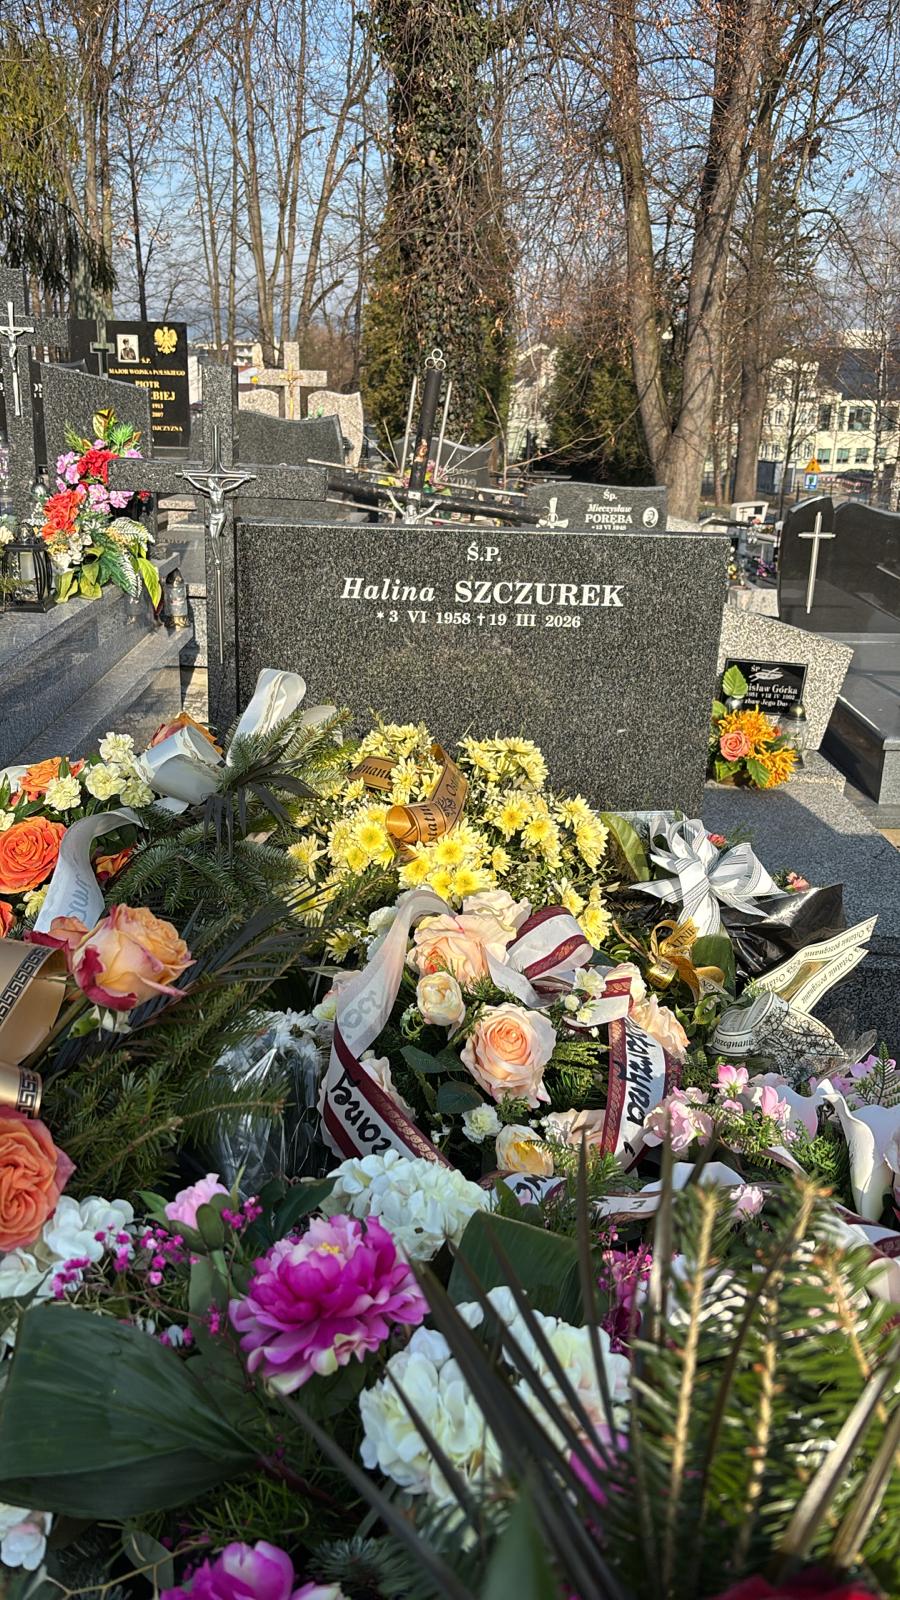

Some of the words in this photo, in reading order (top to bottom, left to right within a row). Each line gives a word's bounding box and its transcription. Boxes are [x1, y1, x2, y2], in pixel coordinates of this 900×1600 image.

[135, 380, 160, 388] PIOTR
[151, 391, 176, 401] BIEJ
[585, 514, 633, 525] PORĘBA
[466, 540, 501, 562] Ś.P.
[340, 577, 435, 601] Halina
[455, 580, 624, 607] SZCZUREK
[407, 610, 427, 623] VI
[436, 612, 470, 624] 1958
[516, 614, 536, 626] III
[545, 616, 581, 627] 2026
